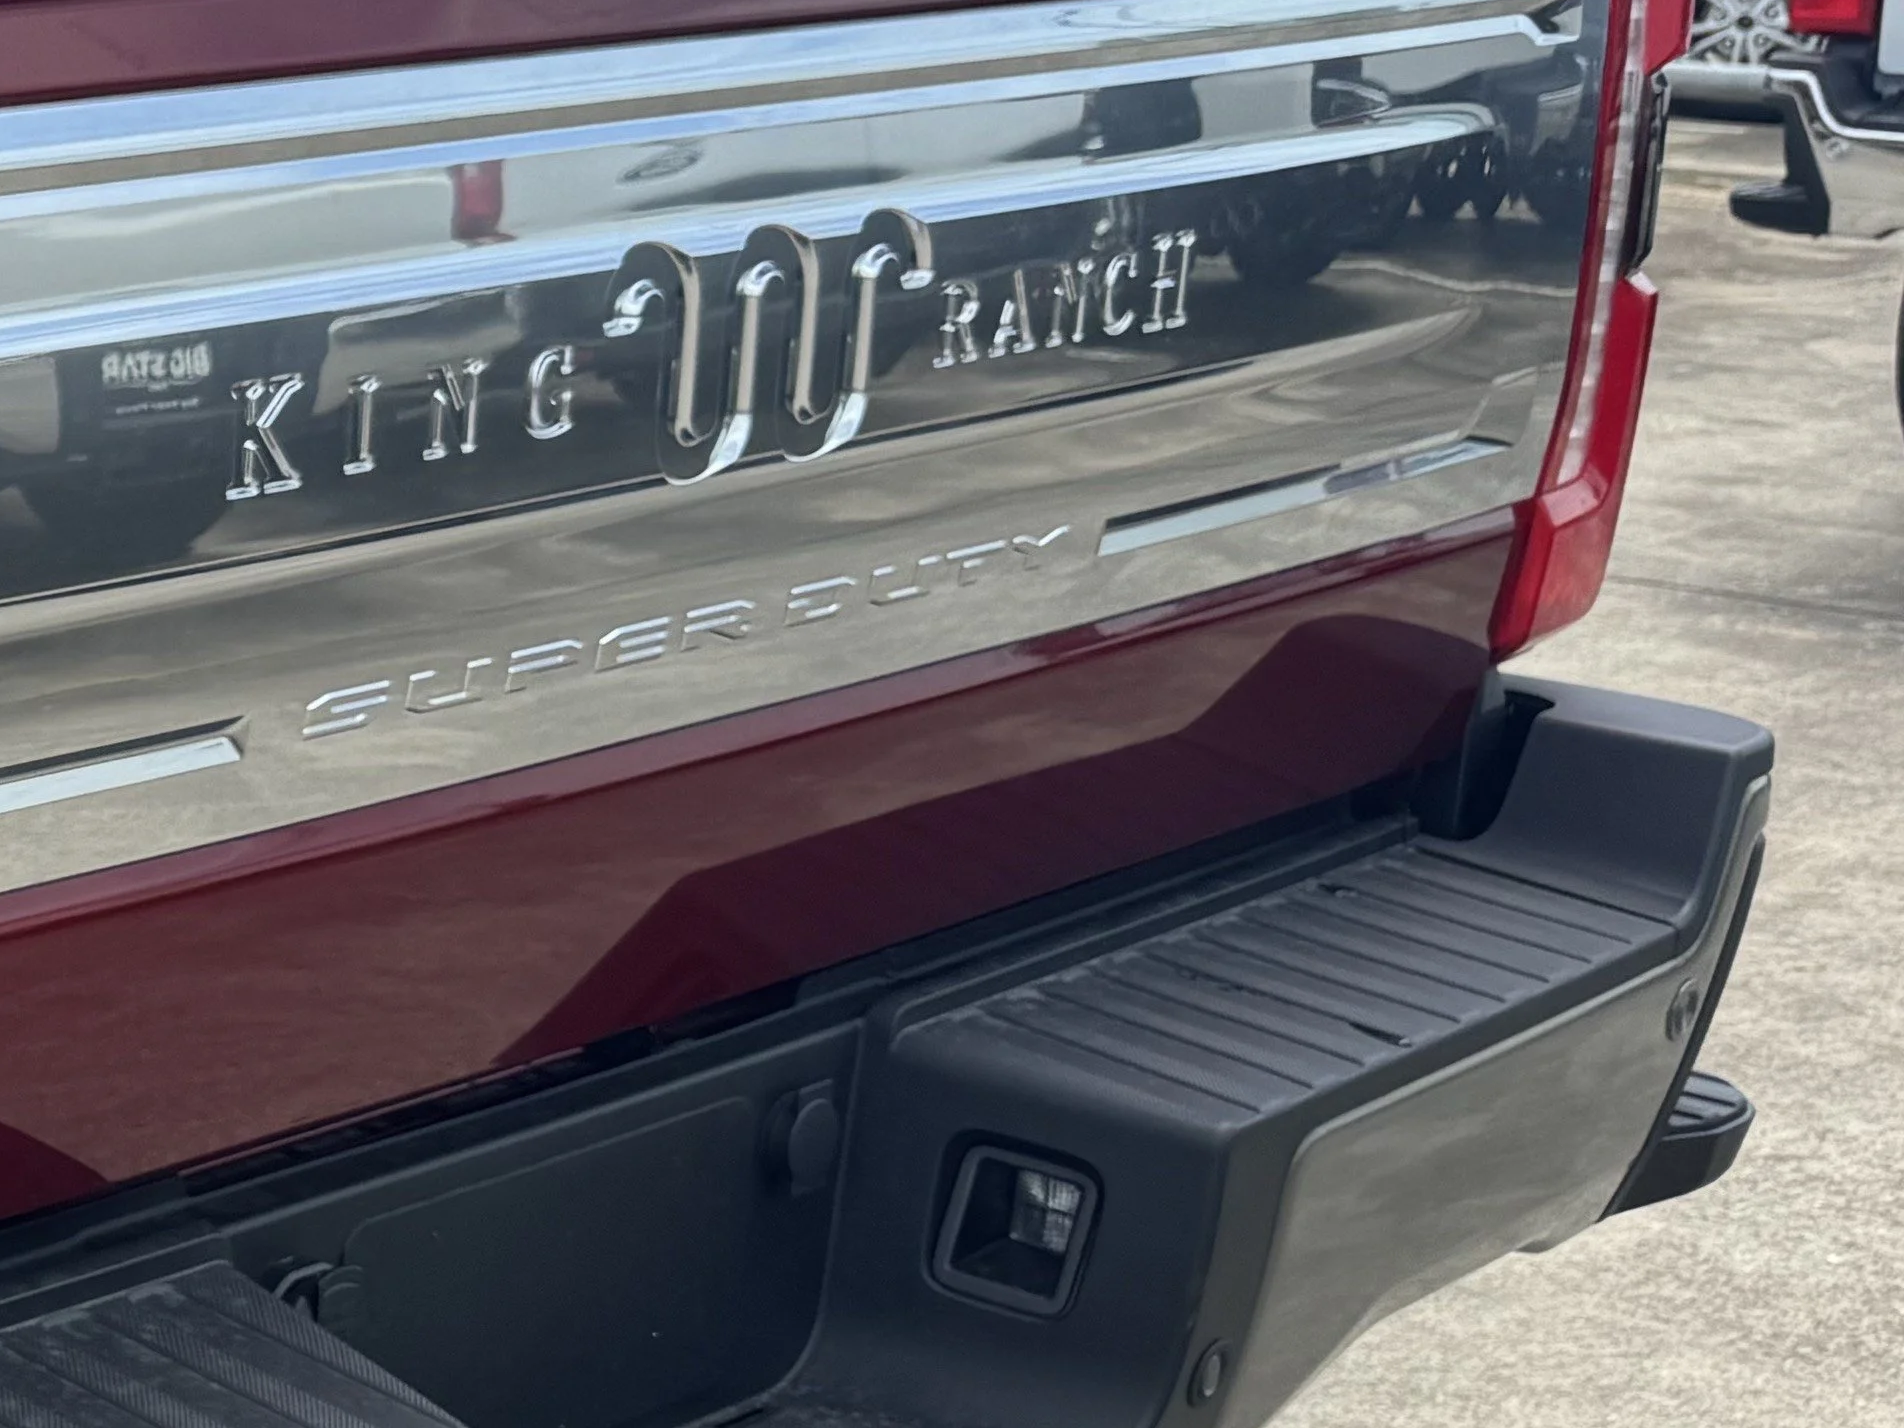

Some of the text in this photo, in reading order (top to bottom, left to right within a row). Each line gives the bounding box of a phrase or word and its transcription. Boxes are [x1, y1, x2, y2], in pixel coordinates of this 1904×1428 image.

[225, 228, 1197, 502] KING RANCH
[301, 524, 1072, 741] SUPER DUTY
